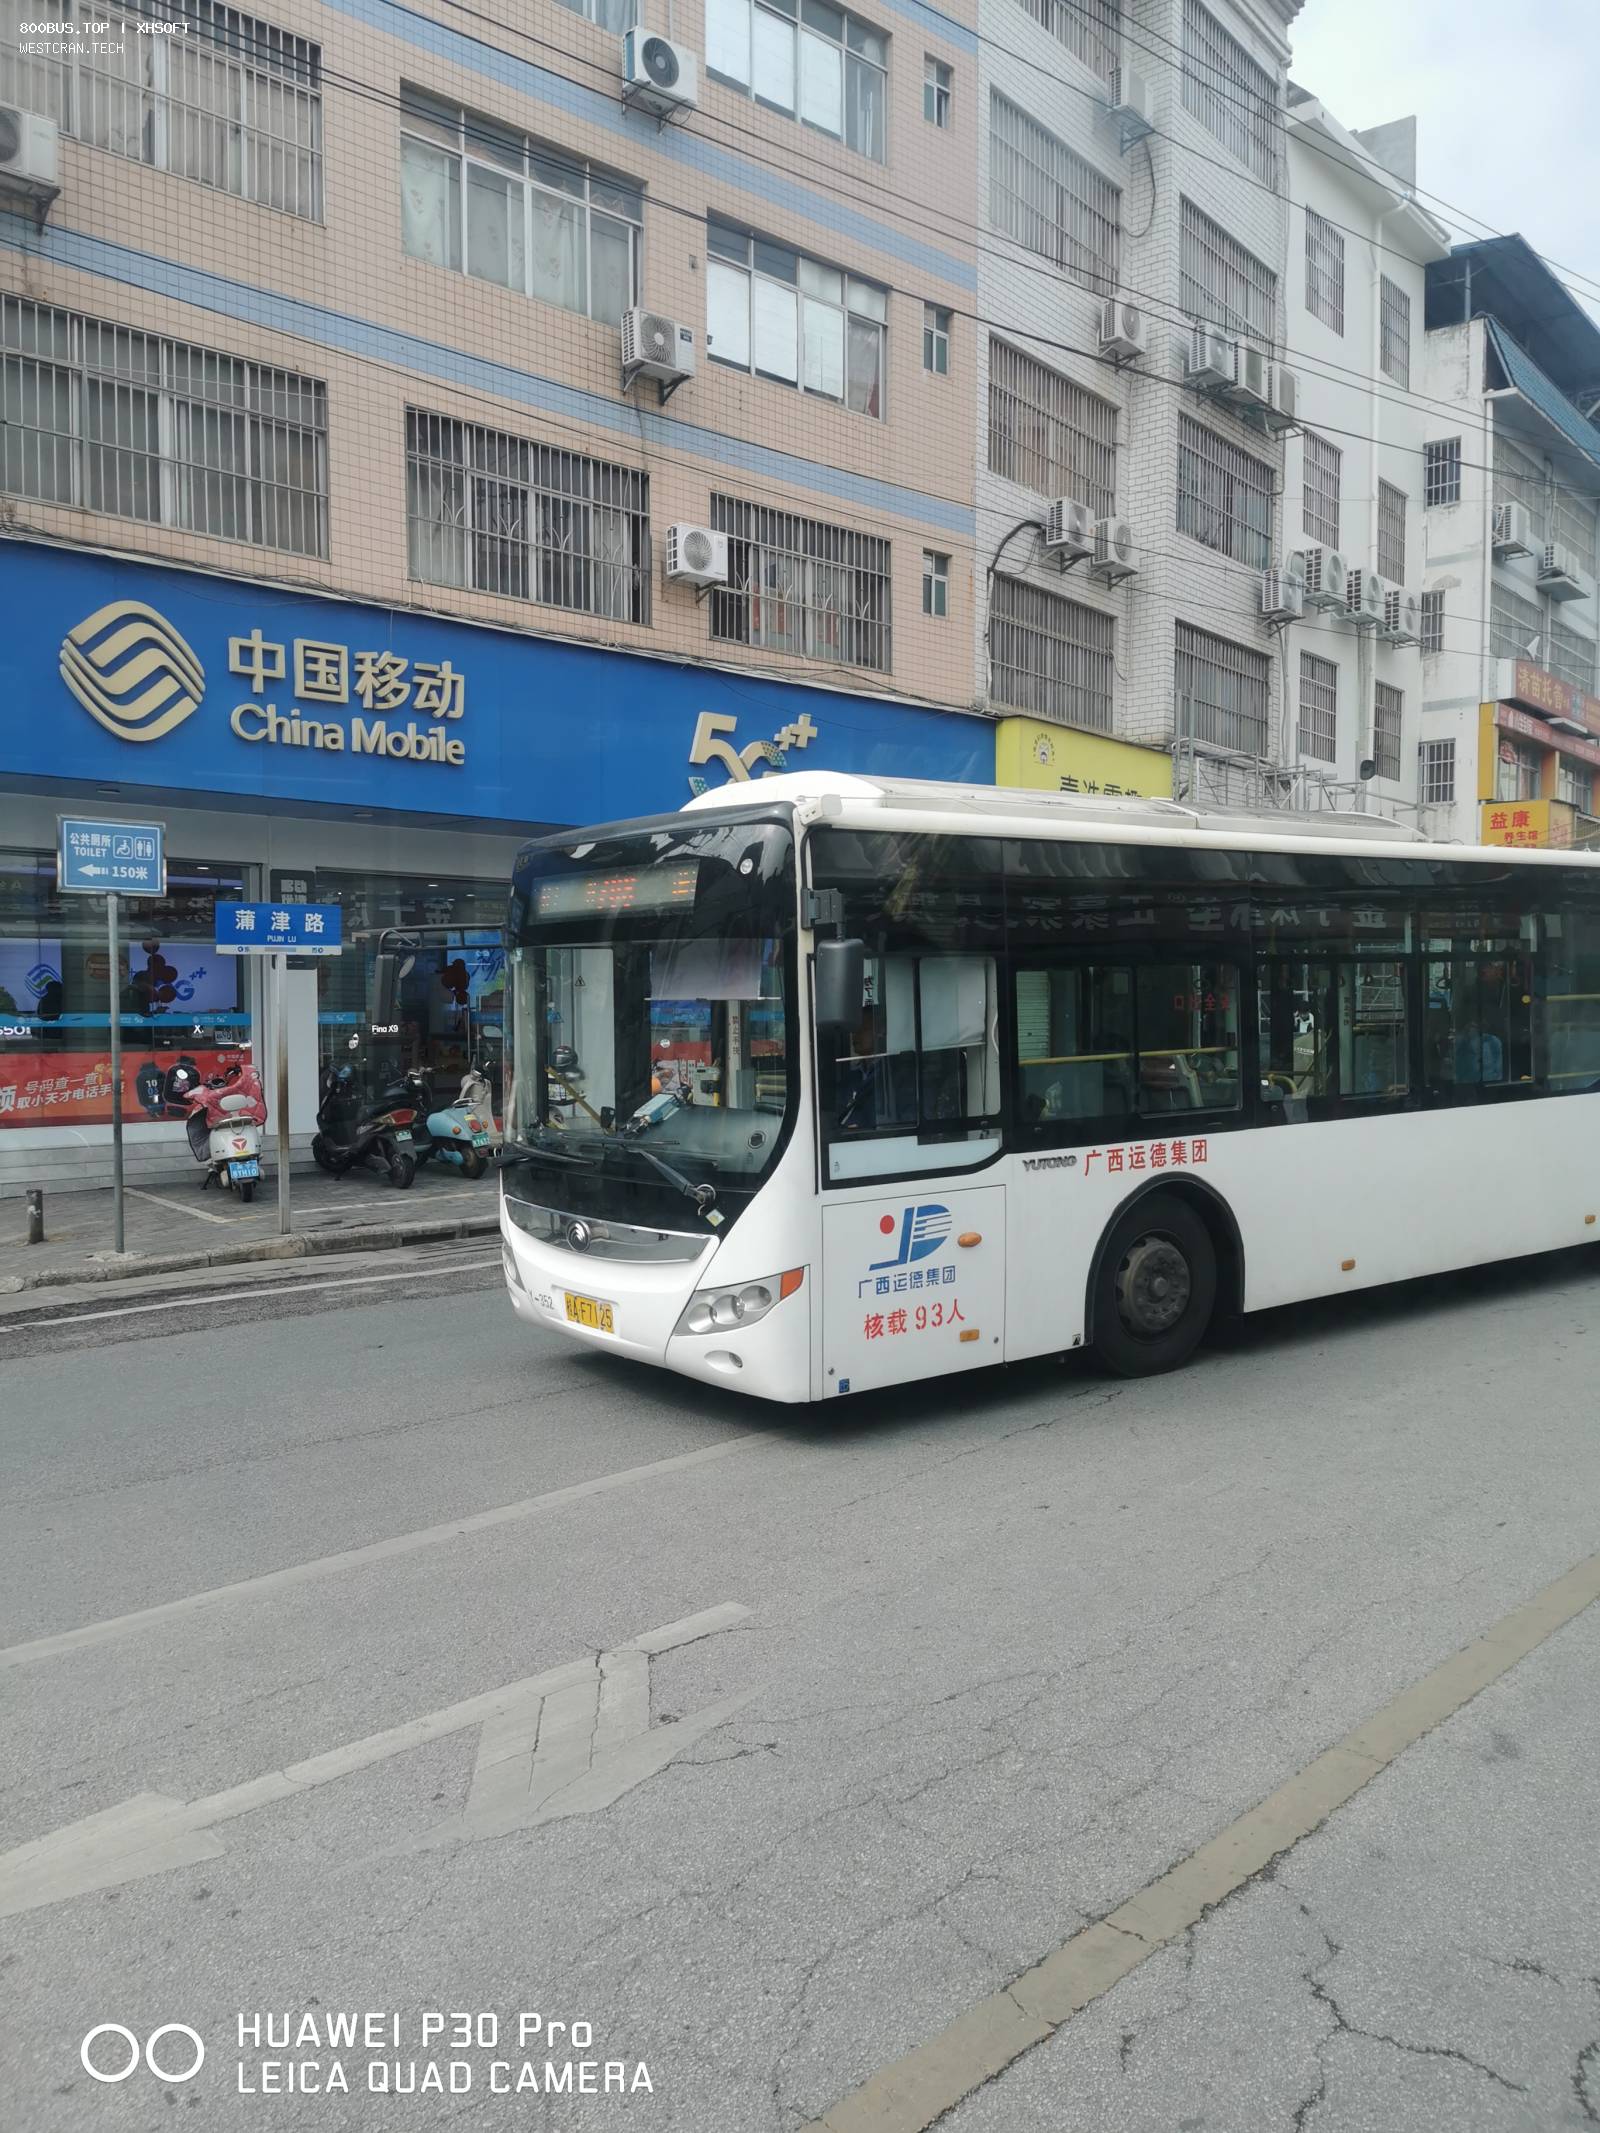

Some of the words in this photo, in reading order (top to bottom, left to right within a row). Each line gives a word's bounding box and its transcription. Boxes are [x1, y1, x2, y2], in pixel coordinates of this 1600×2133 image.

[228, 628, 465, 719] 中国移动
[230, 703, 344, 751] China
[351, 717, 465, 765] Mobile
[1490, 810, 1530, 830] 益康
[70, 832, 112, 848] 公共厕所
[74, 846, 107, 858] TOILET
[112, 866, 148, 880] 150米
[235, 909, 325, 933] 蒲津路
[17, 1082, 125, 1109] 取小天才电话手
[1022, 1155, 1078, 1172] YUTONG
[1084, 1139, 1208, 1177] 广西运德集团
[858, 1265, 956, 1299] 广西运德集团
[864, 1298, 966, 1340] 核载93人
